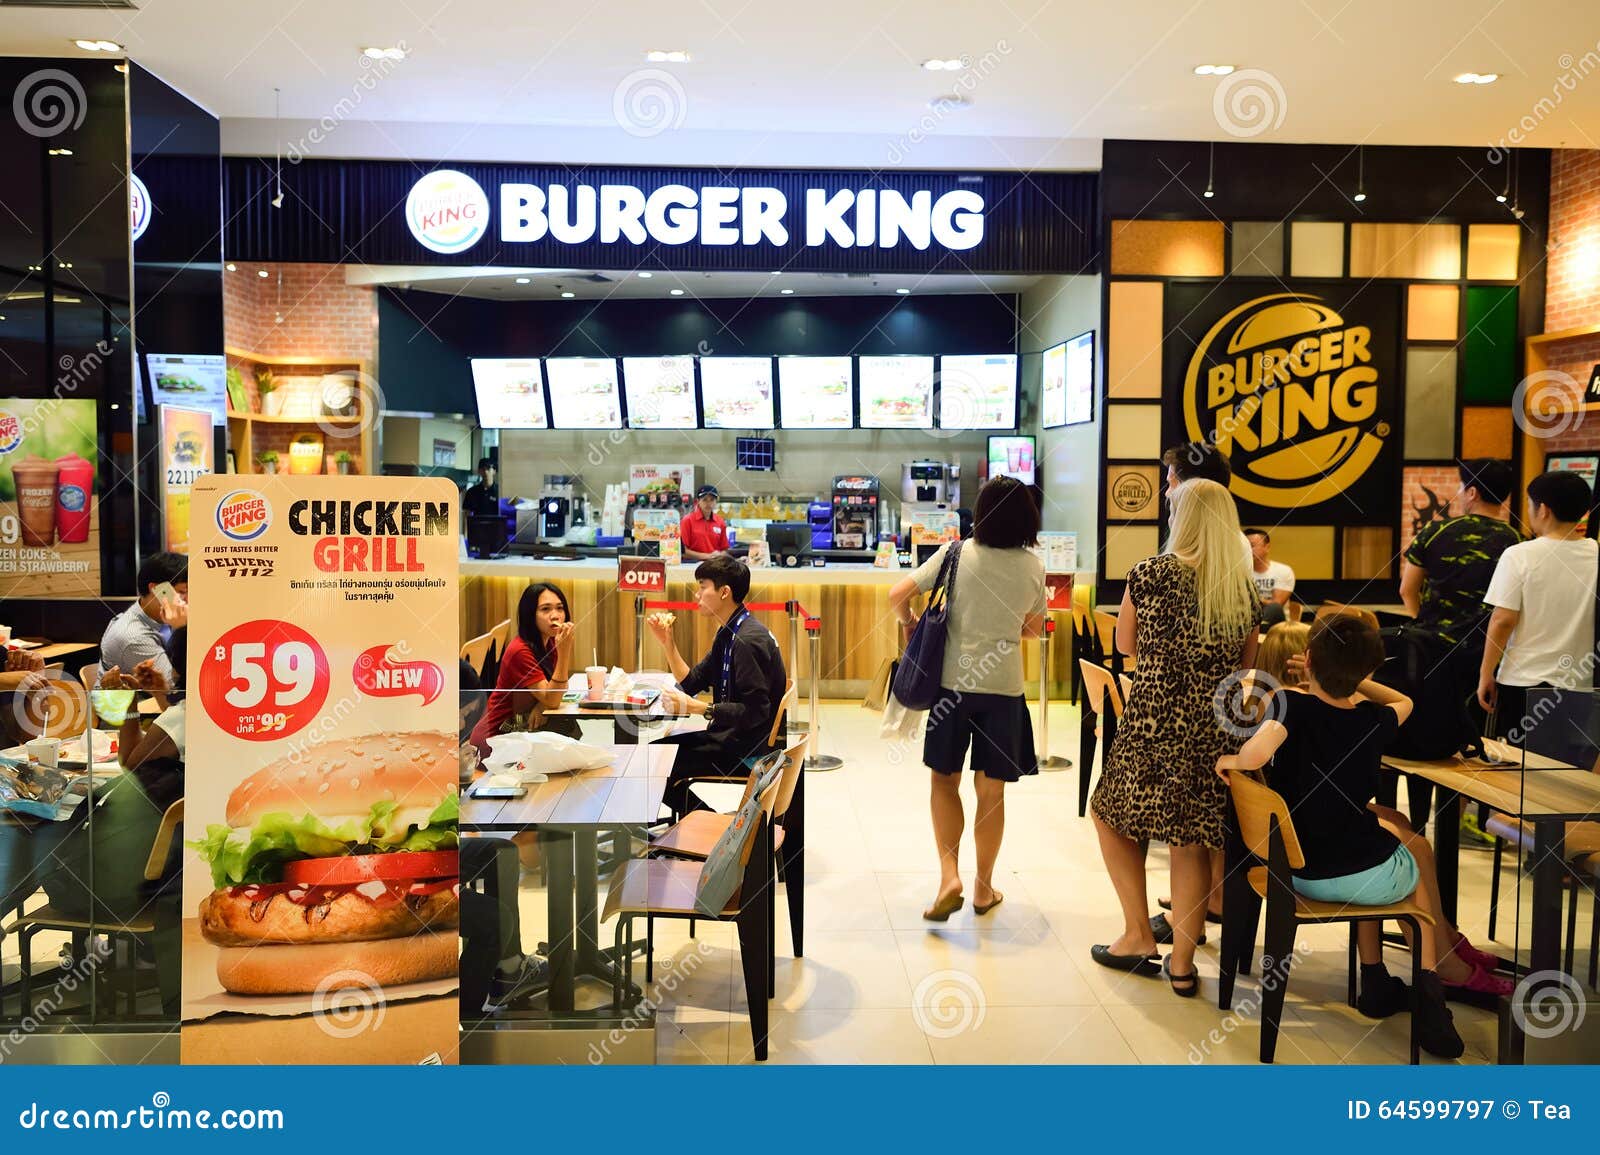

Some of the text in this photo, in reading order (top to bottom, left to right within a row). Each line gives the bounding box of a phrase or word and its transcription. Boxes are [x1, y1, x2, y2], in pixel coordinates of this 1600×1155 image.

[422, 203, 477, 231] KING
[501, 184, 984, 250] BURGER KING
[1208, 326, 1372, 409] BURGER
[1215, 366, 1378, 459] KING
[21, 488, 53, 496] FROZEN
[222, 499, 264, 517] BURGER
[224, 508, 266, 531] KING
[288, 500, 449, 537] CHICKEN
[20, 548, 47, 560] COKE
[313, 537, 425, 573] GRILL
[20, 561, 90, 573] STRAWBERRY
[204, 558, 274, 569] DELIVERY
[228, 568, 274, 577] 1112
[625, 570, 660, 585] OUT
[375, 669, 423, 689] NEW
[236, 723, 255, 733] ปกติ
[239, 715, 254, 724] จาก
